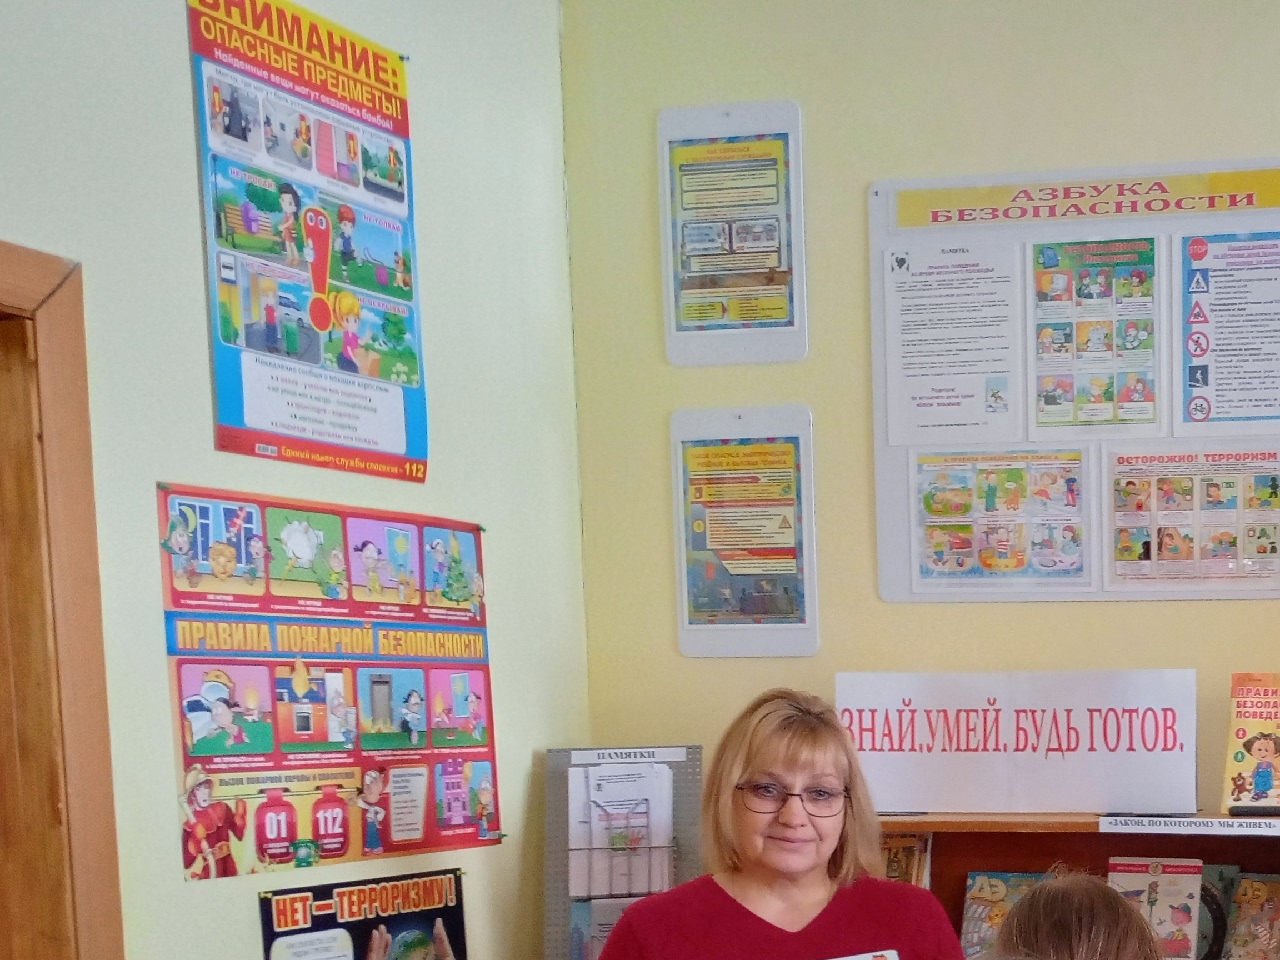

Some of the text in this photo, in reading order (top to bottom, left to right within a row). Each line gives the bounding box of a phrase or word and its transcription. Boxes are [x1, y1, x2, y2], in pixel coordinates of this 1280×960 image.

[200, 16, 298, 79] ОПАСНЫЕ
[304, 61, 402, 119] ПРЕДМЕТЫ!
[214, 48, 393, 130] Найденные вещи могут оказаться бомбой!
[1010, 181, 1170, 203] АЗБУКА
[930, 192, 1257, 224] БЕЗОПАСНОСТИ
[1189, 245, 1208, 254] STOP
[281, 446, 309, 461] Единый
[335, 455, 365, 470] службы
[404, 461, 425, 477] 112
[1117, 452, 1278, 465] ОСТОРОЖНО! ТЕРРОРИЗМ
[176, 620, 485, 658] ПРАВИЛА ПОЖАРНОЙ БЕЗОПАСНОСТИ
[1013, 707, 1080, 760] БУДЬ
[1086, 706, 1184, 753] ГОТОВ.
[597, 751, 656, 759] ПАМЯТКИ
[265, 811, 288, 839] 01
[316, 807, 343, 835] 112
[1148, 819, 1162, 827] ПО
[1163, 820, 1214, 828] КОТОРОМУ
[273, 893, 312, 930] НЕТ
[335, 875, 455, 921] ТЕРРОРИЗМУ!
